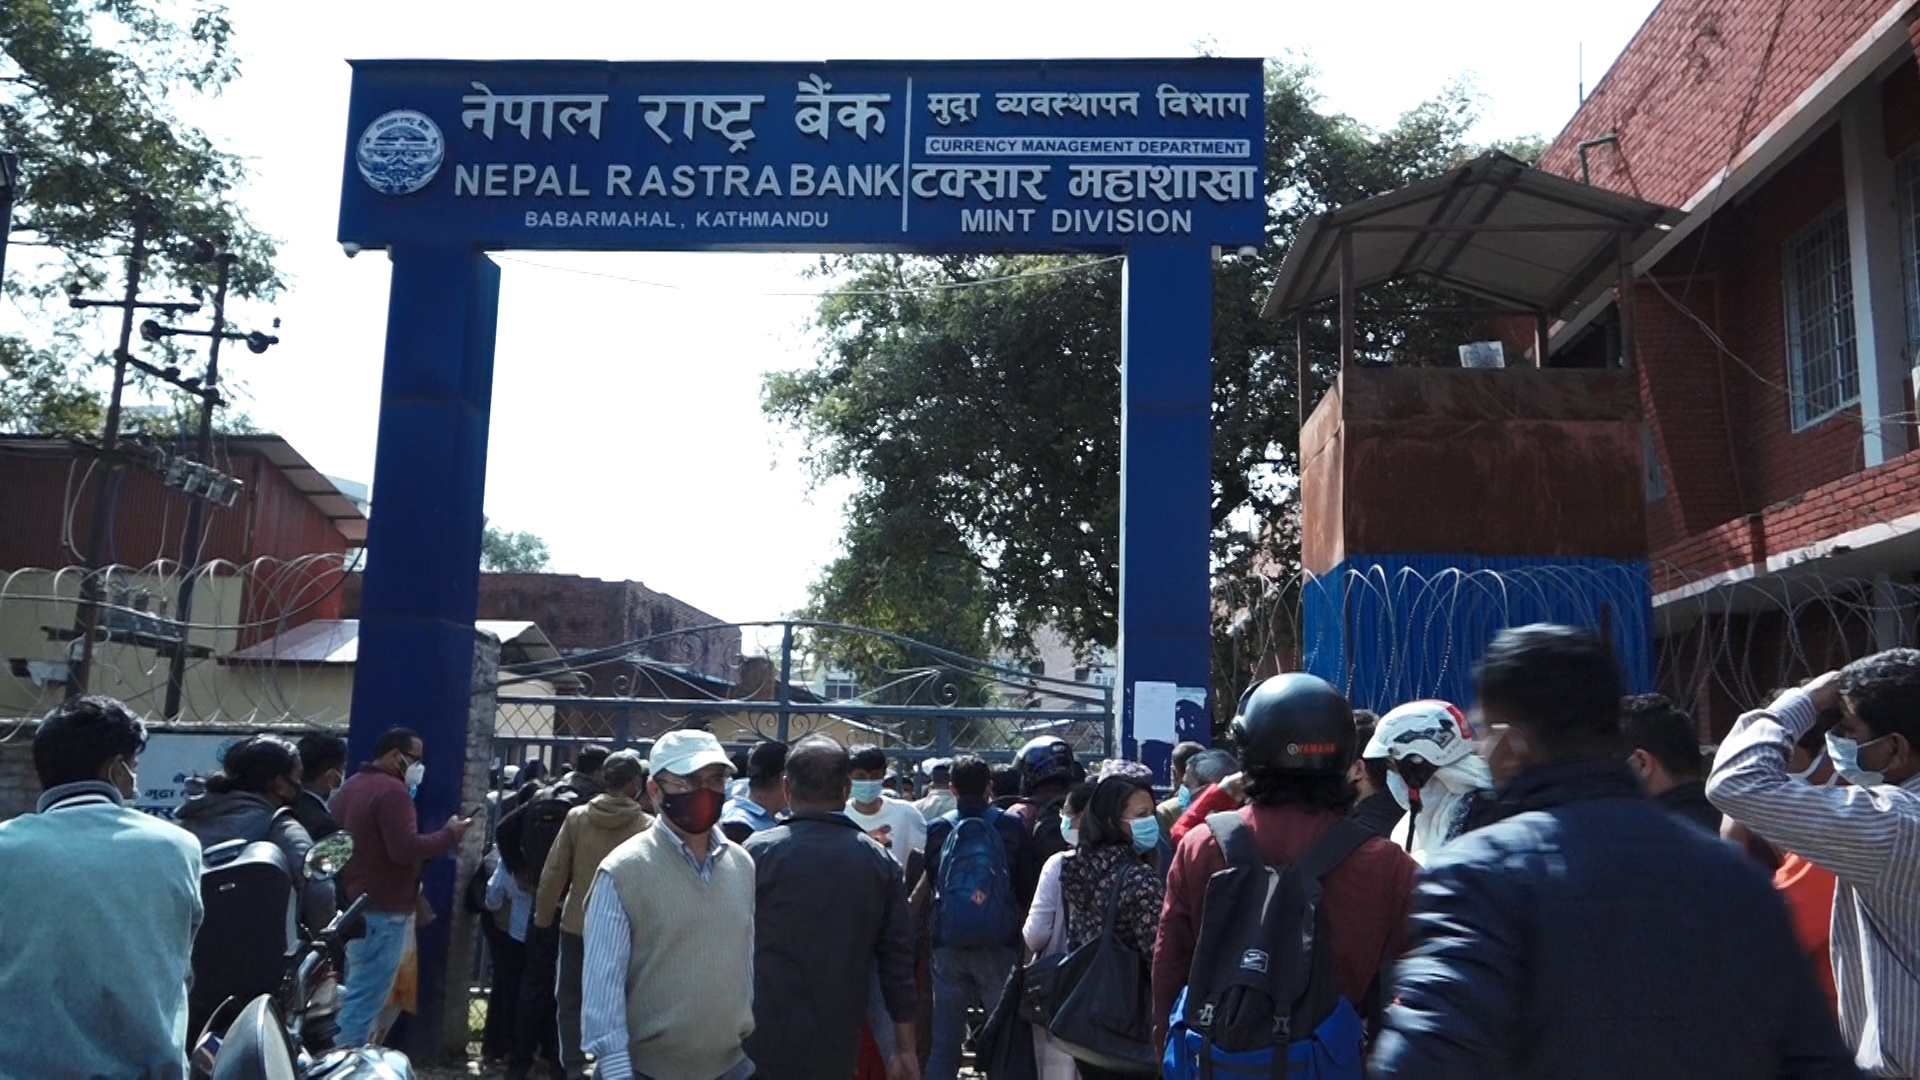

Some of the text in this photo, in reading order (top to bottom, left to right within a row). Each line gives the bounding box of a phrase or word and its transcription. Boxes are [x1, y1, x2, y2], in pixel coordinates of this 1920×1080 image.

[462, 73, 891, 153] नेपाल राष्ट्र बैंक
[927, 83, 1250, 125] मुद्रा व्यवस्थापन विभाग
[930, 139, 1246, 154] CURRENCY MANAGEMENT DEPARTMENT
[454, 163, 901, 197] NEPAL RASTRA BANK
[911, 163, 1258, 202] टक्सार महाशाखा
[525, 211, 829, 229] BABARMAHAL, KATHMANDU
[961, 209, 1192, 232] MINT DIVISION
